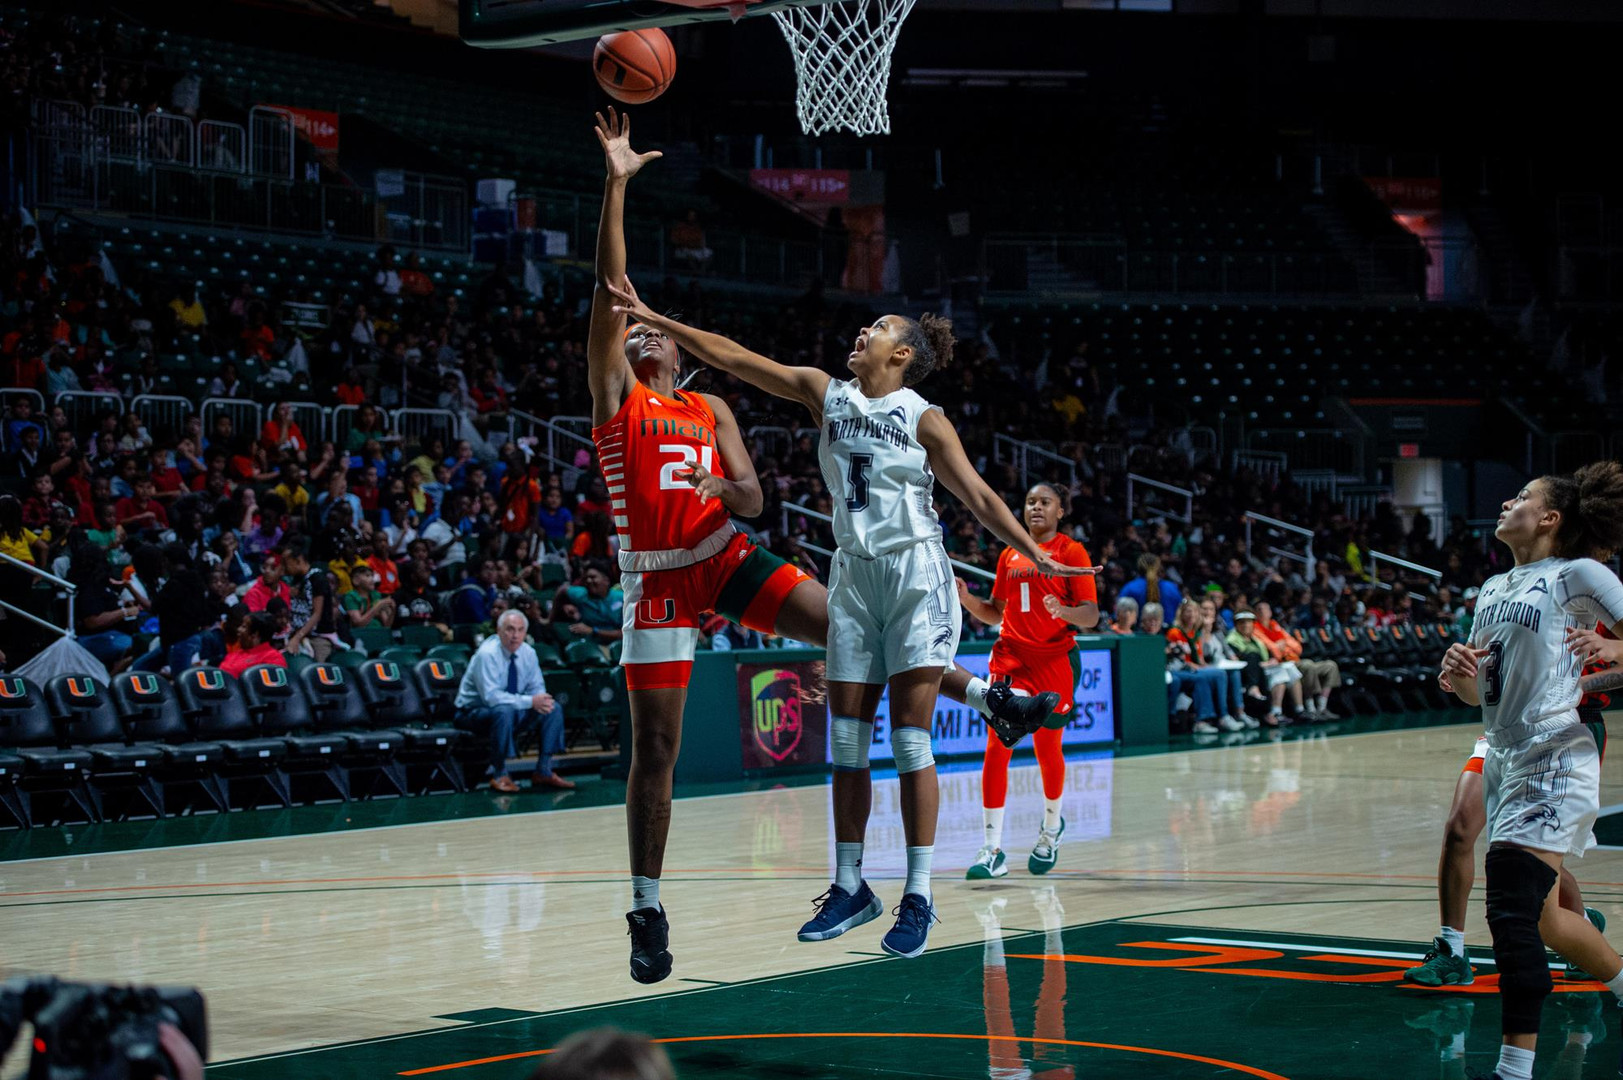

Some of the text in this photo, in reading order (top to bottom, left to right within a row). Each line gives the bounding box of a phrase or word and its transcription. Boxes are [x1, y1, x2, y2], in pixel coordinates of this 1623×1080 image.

[828, 416, 909, 453] NORTH FLORIDA
[659, 444, 713, 490] 21
[845, 453, 874, 512] 5
[638, 598, 676, 624] U
[1020, 582, 1031, 613] 1
[1496, 600, 1541, 633] FLORIDA
[1082, 668, 1102, 690] OF
[1485, 641, 1505, 706] 3
[757, 697, 798, 746] ups
